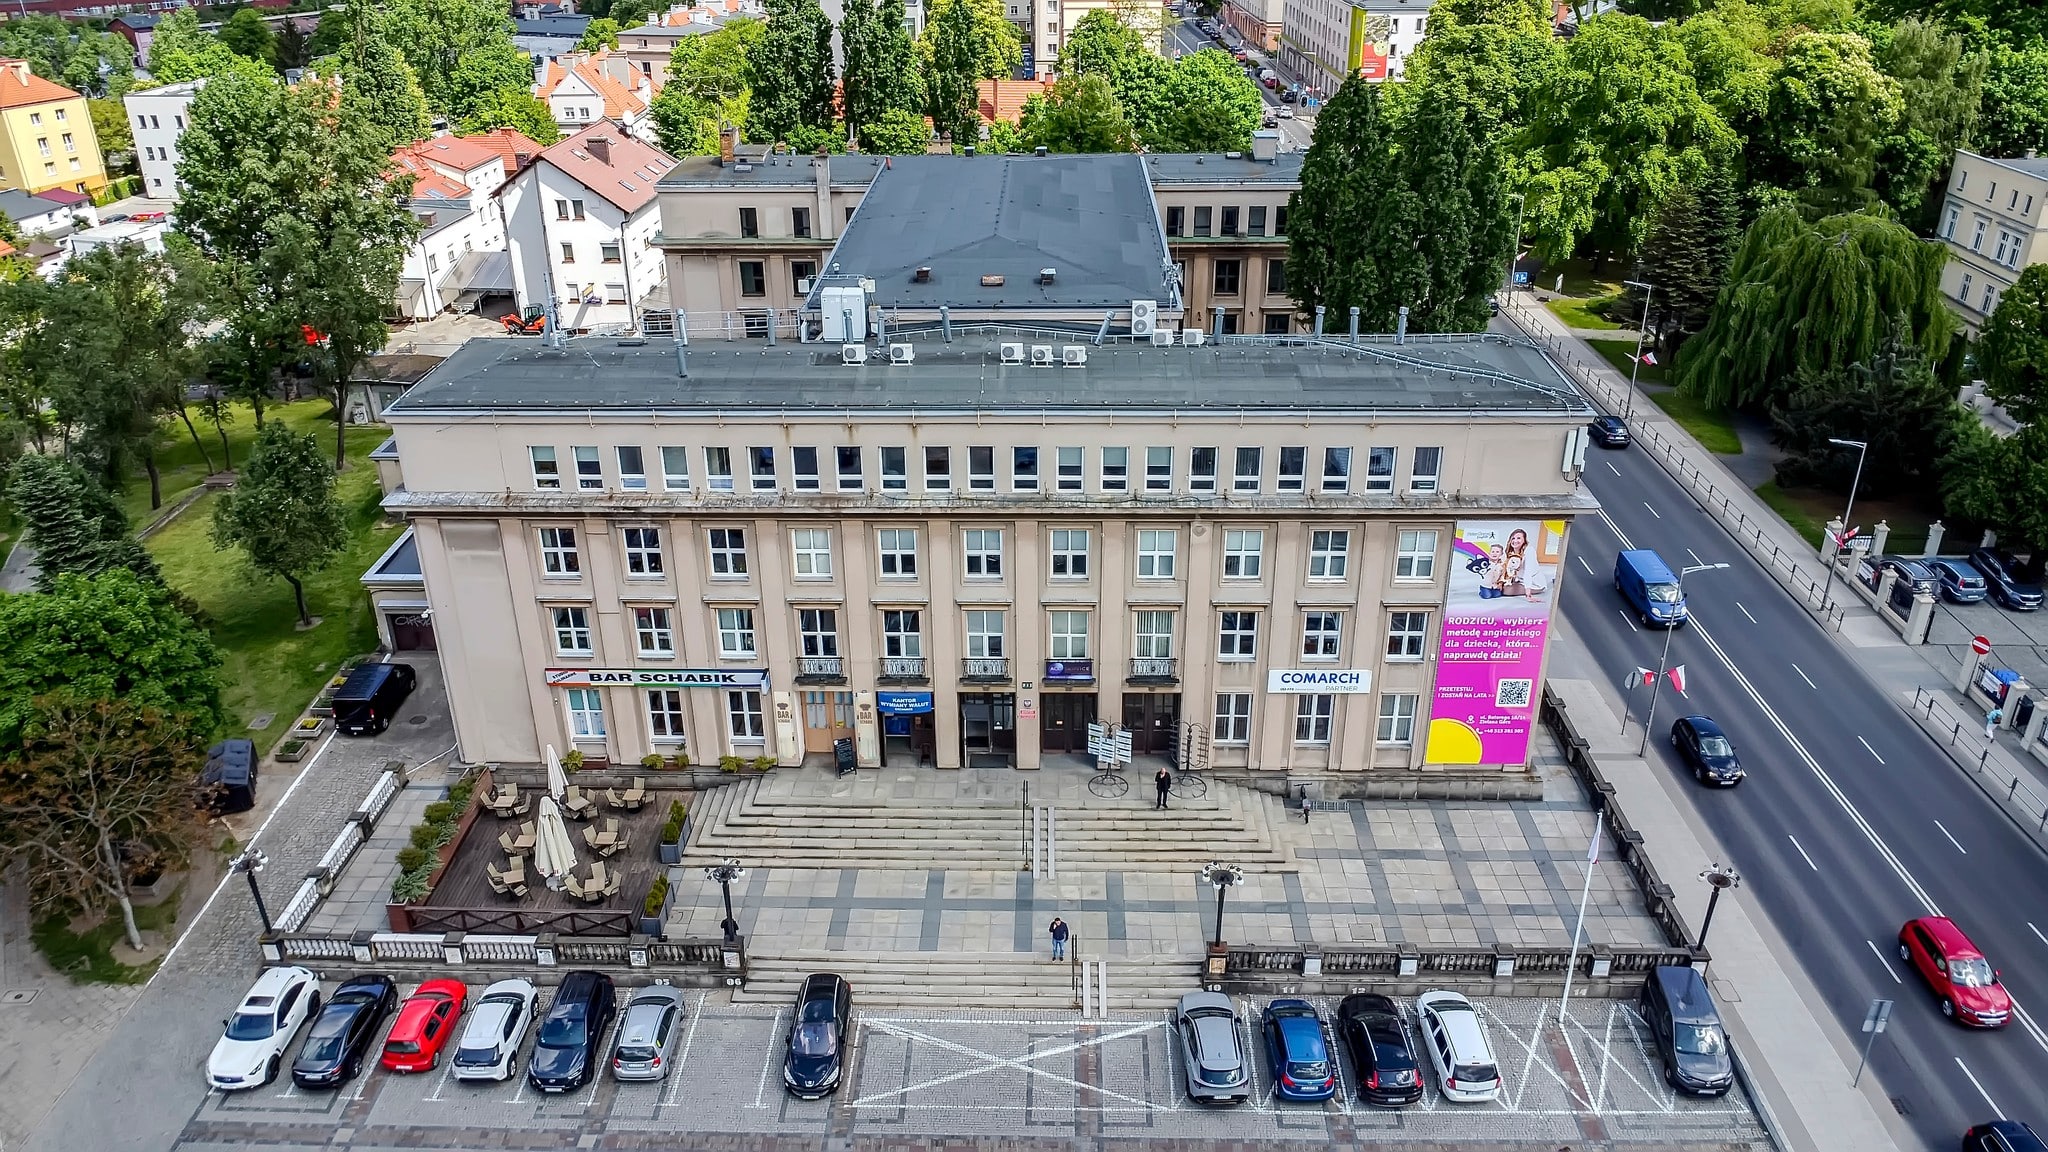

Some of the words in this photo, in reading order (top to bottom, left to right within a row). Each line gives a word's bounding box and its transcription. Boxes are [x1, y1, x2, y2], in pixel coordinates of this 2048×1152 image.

[1448, 617, 1497, 626] RODZICU,
[1503, 617, 1544, 627] wybierz
[1446, 628, 1480, 638] metodę
[1482, 628, 1541, 638] angielskiego
[1444, 639, 1459, 648] dla
[1463, 639, 1501, 649] dziecka,
[1505, 639, 1539, 648] która...
[1443, 651, 1488, 660] naprawdę
[1490, 651, 1522, 659] działa!
[589, 673, 633, 683] BAR
[639, 673, 736, 683] SCHABIK
[1281, 673, 1360, 684] COMARCH
[777, 711, 789, 719] BAR
[859, 712, 872, 720] BAR
[1207, 984, 1221, 992] 10
[1281, 986, 1295, 994] 11
[1351, 987, 1366, 995] 12
